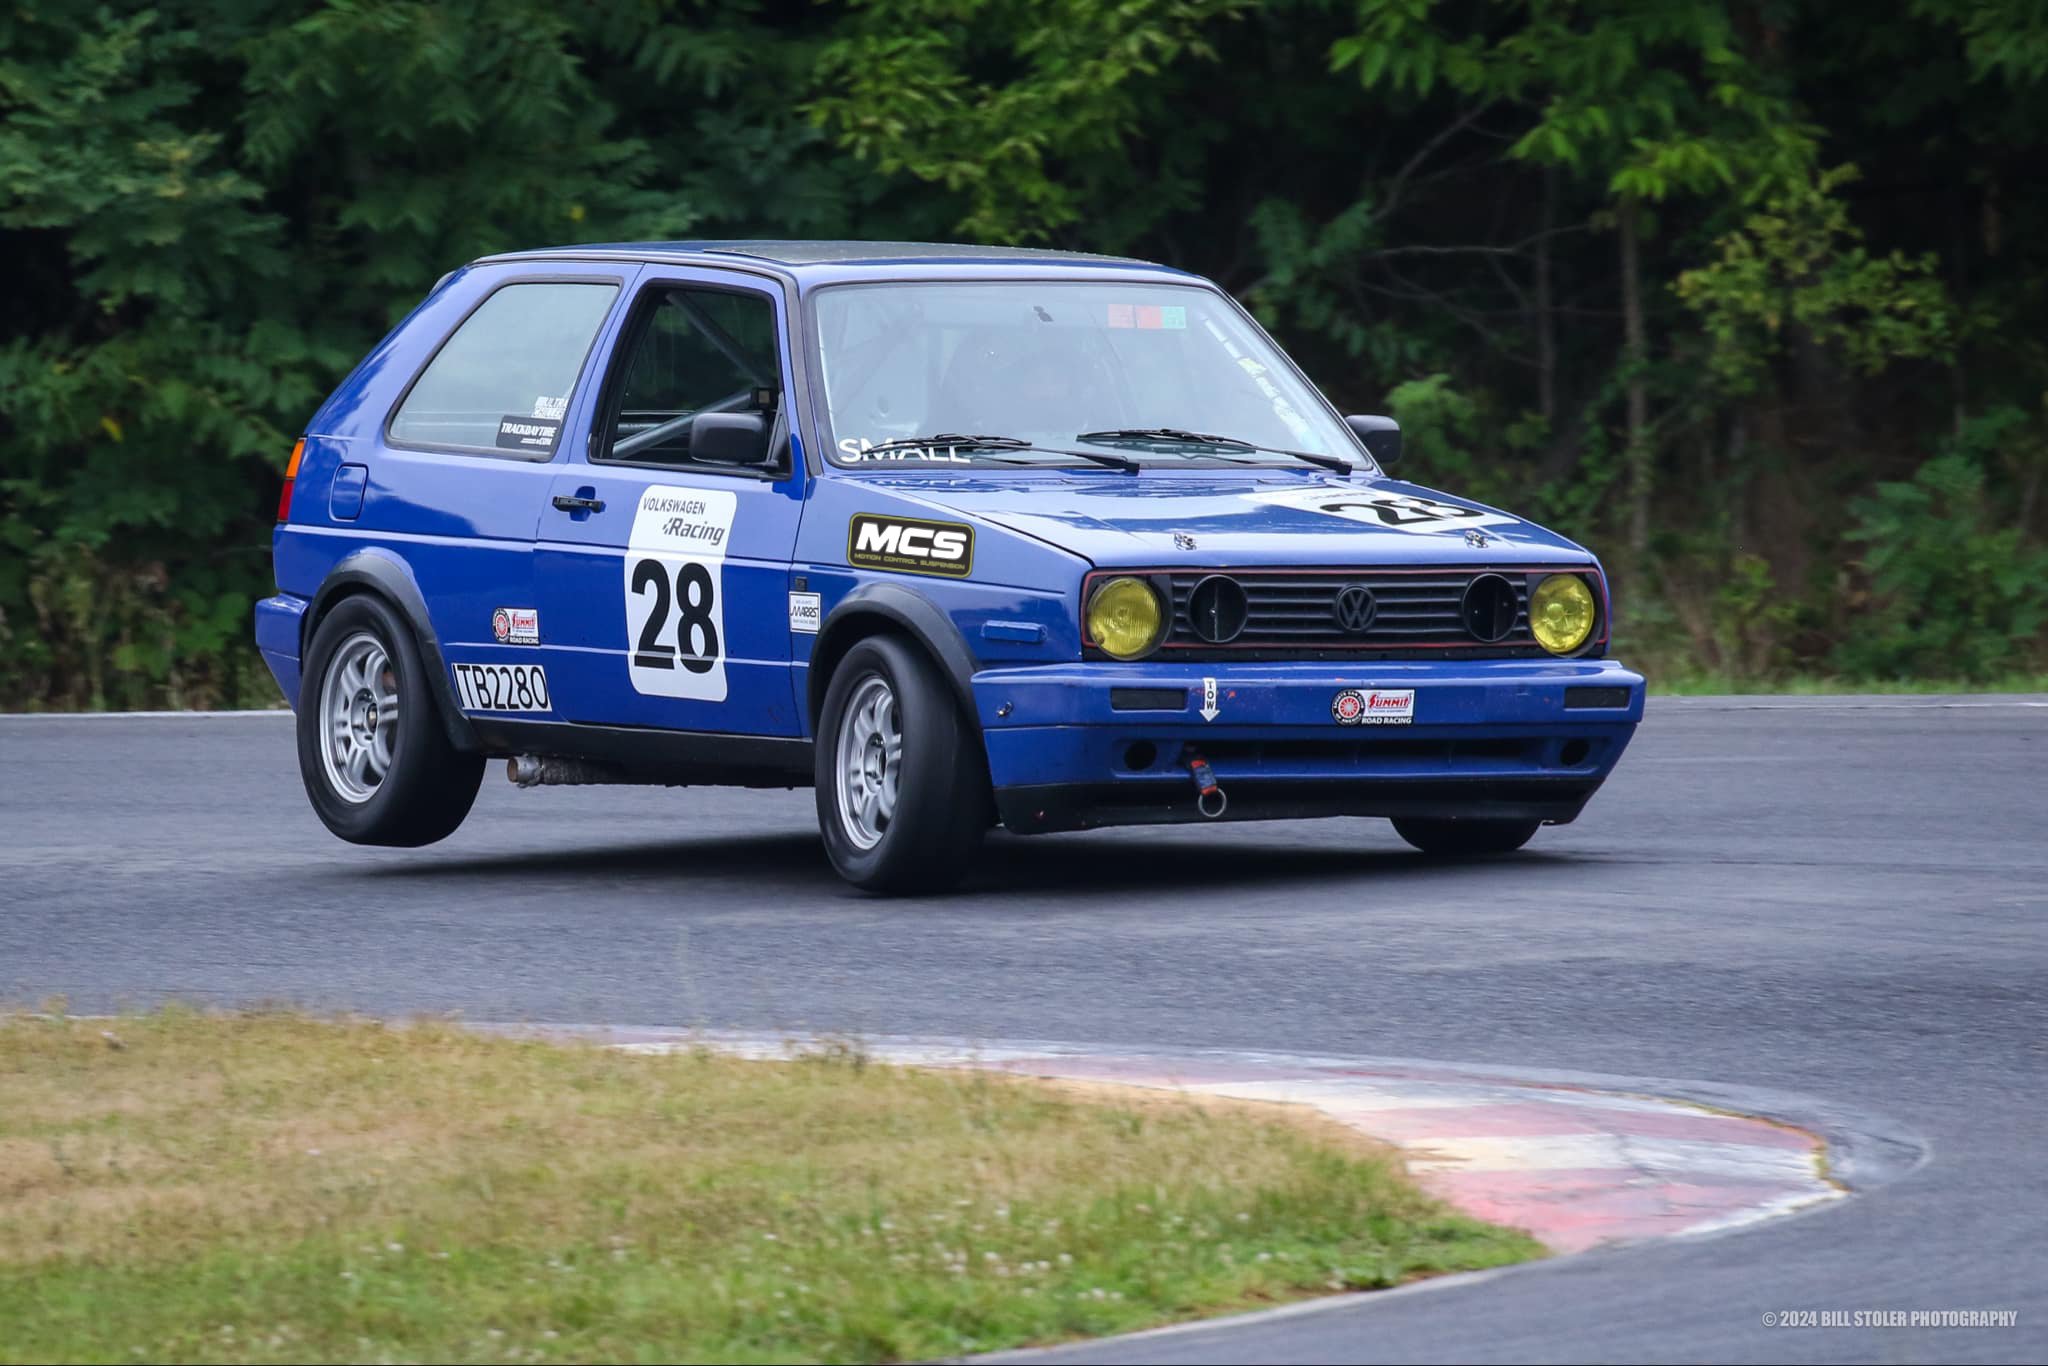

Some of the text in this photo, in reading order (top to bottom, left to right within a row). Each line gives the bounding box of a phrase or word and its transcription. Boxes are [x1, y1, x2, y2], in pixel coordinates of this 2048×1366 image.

[643, 497, 707, 515] VOLKSWAGEN
[668, 517, 725, 546] Racing
[855, 522, 967, 560] MCS
[854, 553, 965, 570] MOTION CONTROL SUSPENSION
[631, 558, 719, 674] 28
[1206, 680, 1215, 710] TOW
[1361, 717, 1412, 725] ROAD RACING
